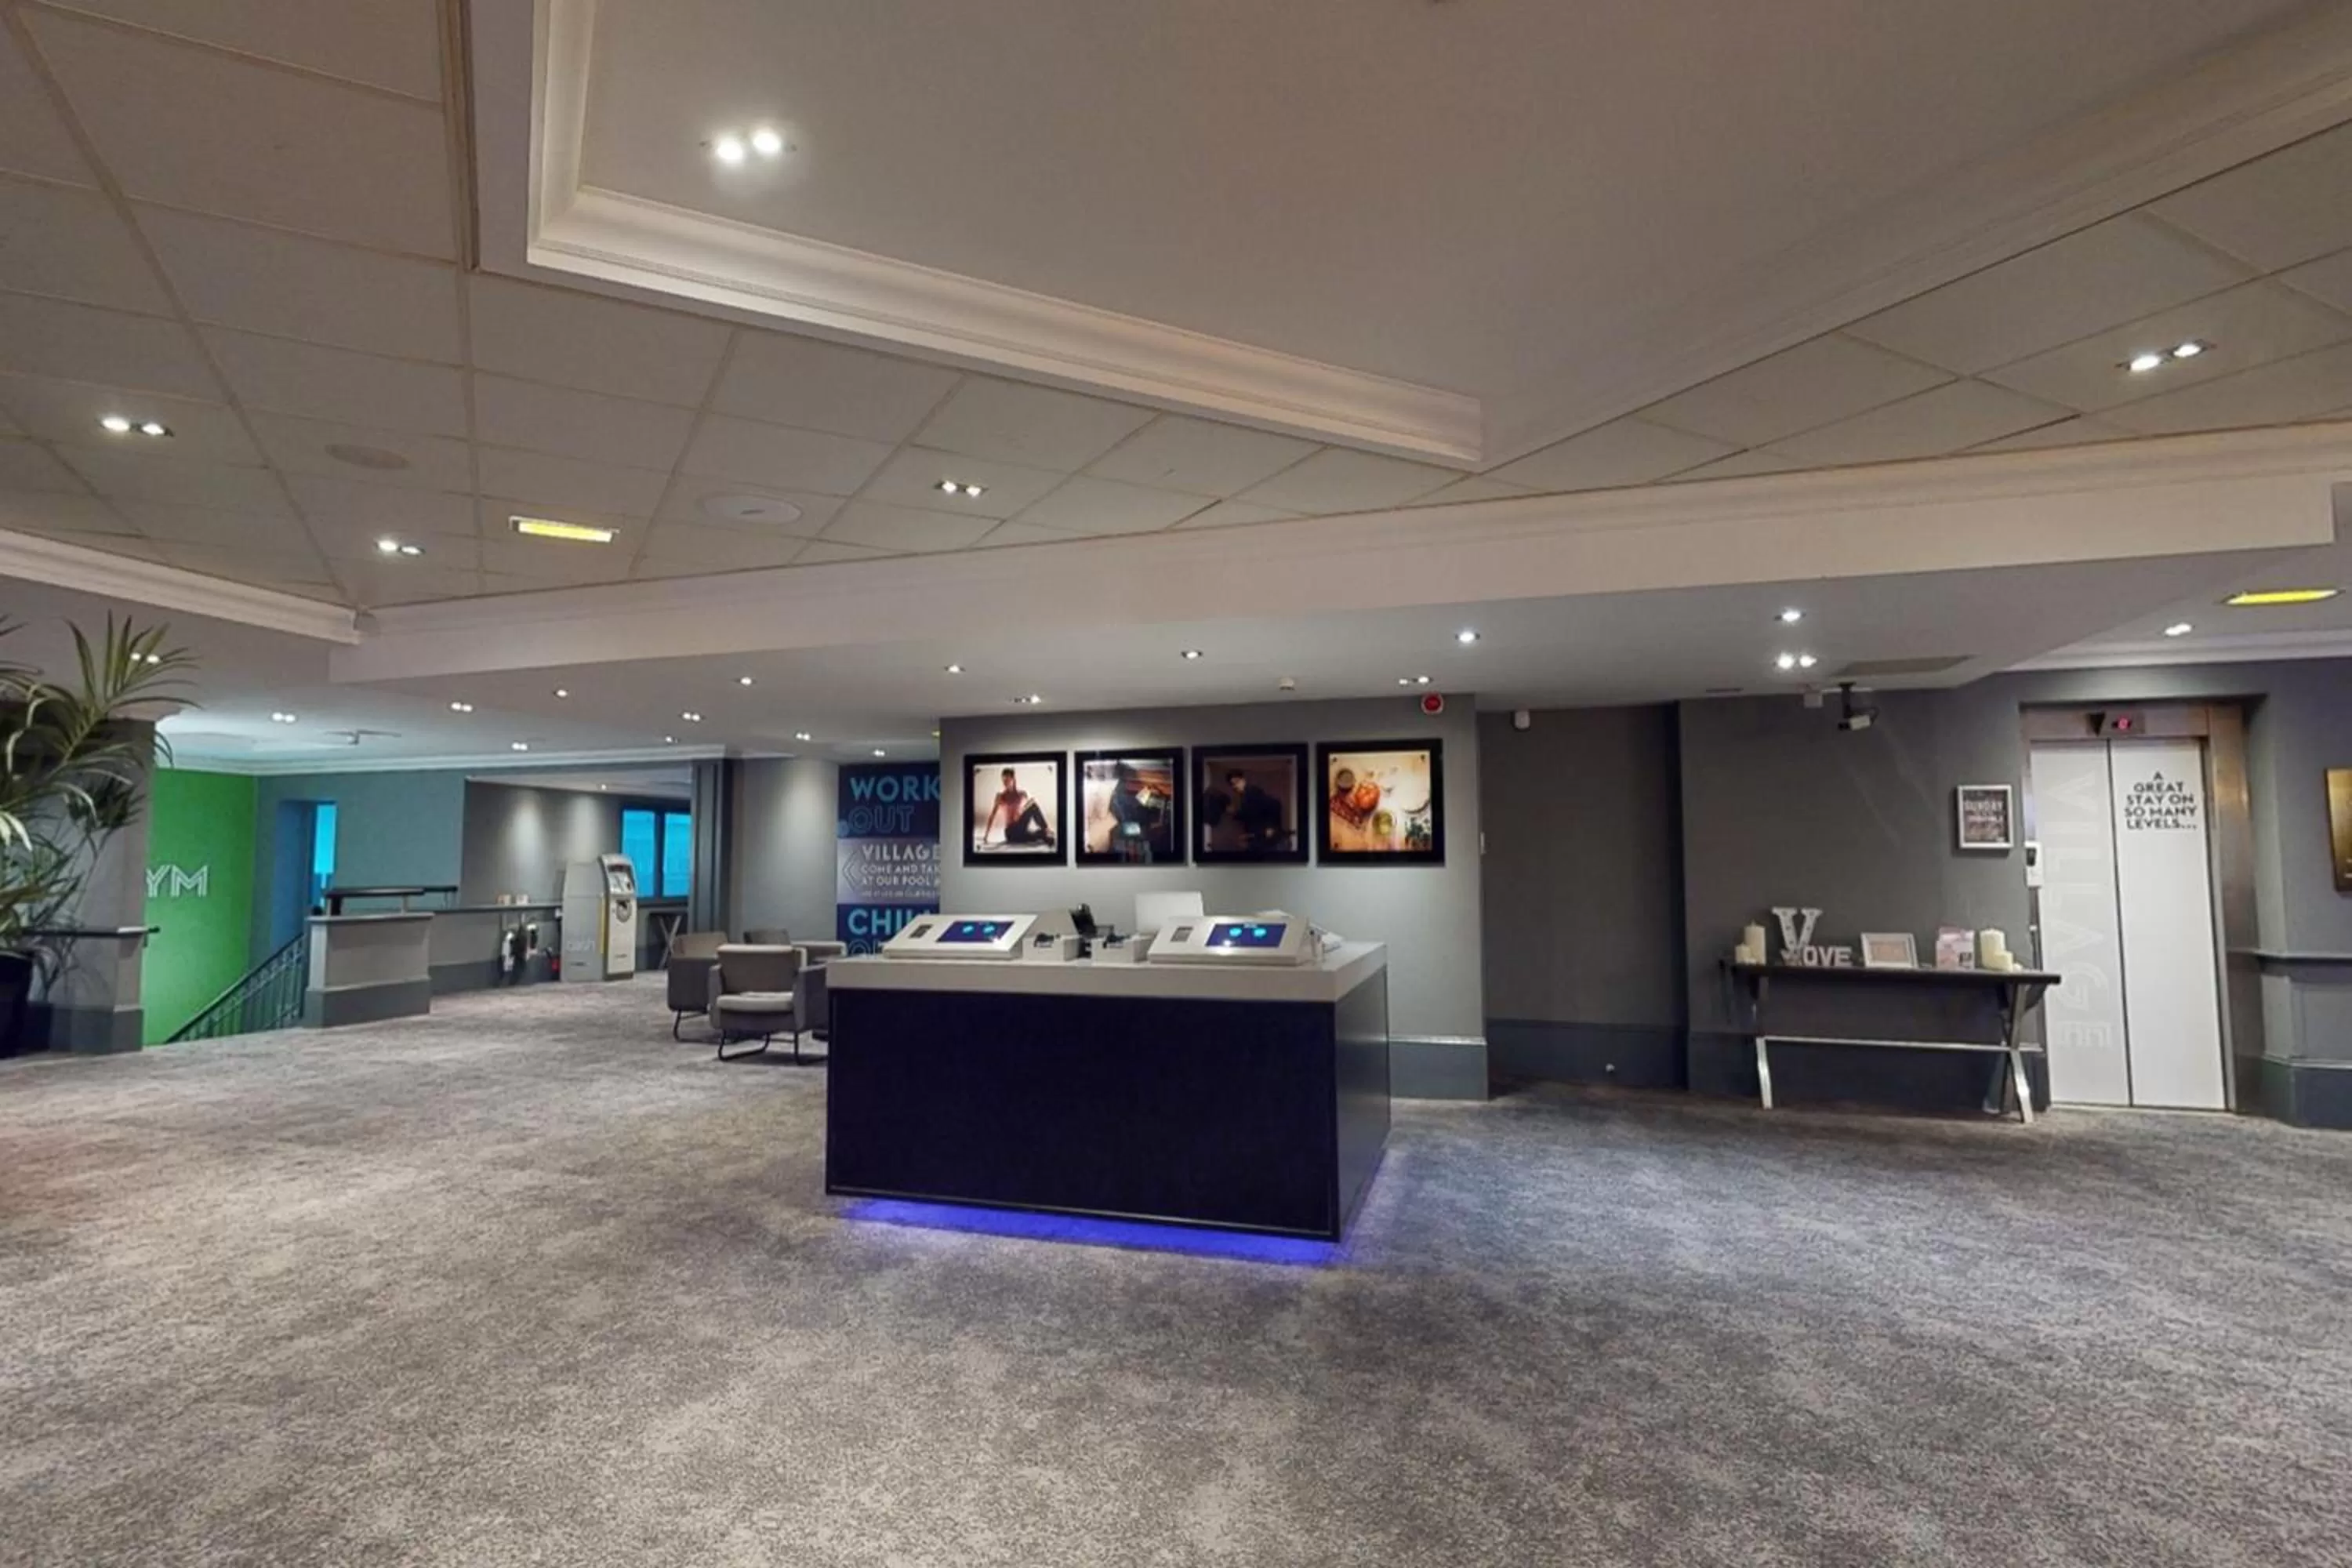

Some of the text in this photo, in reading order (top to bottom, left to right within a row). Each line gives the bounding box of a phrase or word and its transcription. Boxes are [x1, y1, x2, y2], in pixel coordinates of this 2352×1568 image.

[2153, 771, 2164, 781] A
[849, 775, 940, 803] WORK
[2133, 781, 2183, 793] GREAT
[2126, 793, 2194, 805] STAY ON
[2125, 806, 2197, 817] SO MANY
[848, 805, 915, 833] OUT
[1772, 906, 1824, 955] V
